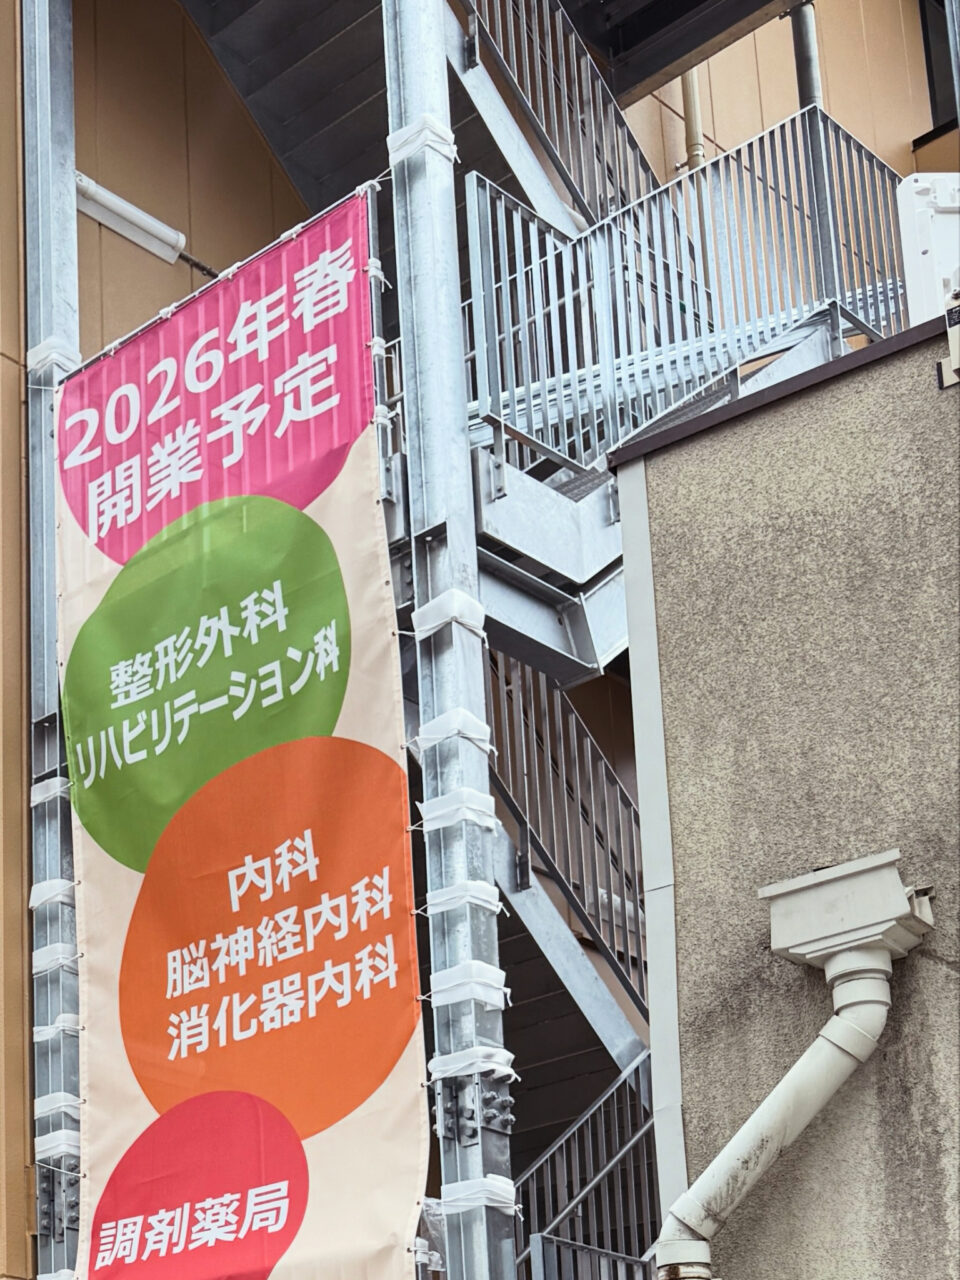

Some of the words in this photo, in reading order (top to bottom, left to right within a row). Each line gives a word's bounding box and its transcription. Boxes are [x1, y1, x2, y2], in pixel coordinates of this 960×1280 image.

[63, 237, 356, 470] 2026年春
[87, 343, 341, 546] 開業予定
[75, 618, 340, 789] リハビリテーション科
[109, 579, 289, 710] 整形外科
[165, 865, 393, 999] 脳神経内科
[227, 828, 320, 913] 内科
[166, 934, 399, 1061] 消化器内科
[94, 1180, 290, 1271] 調剤薬局
